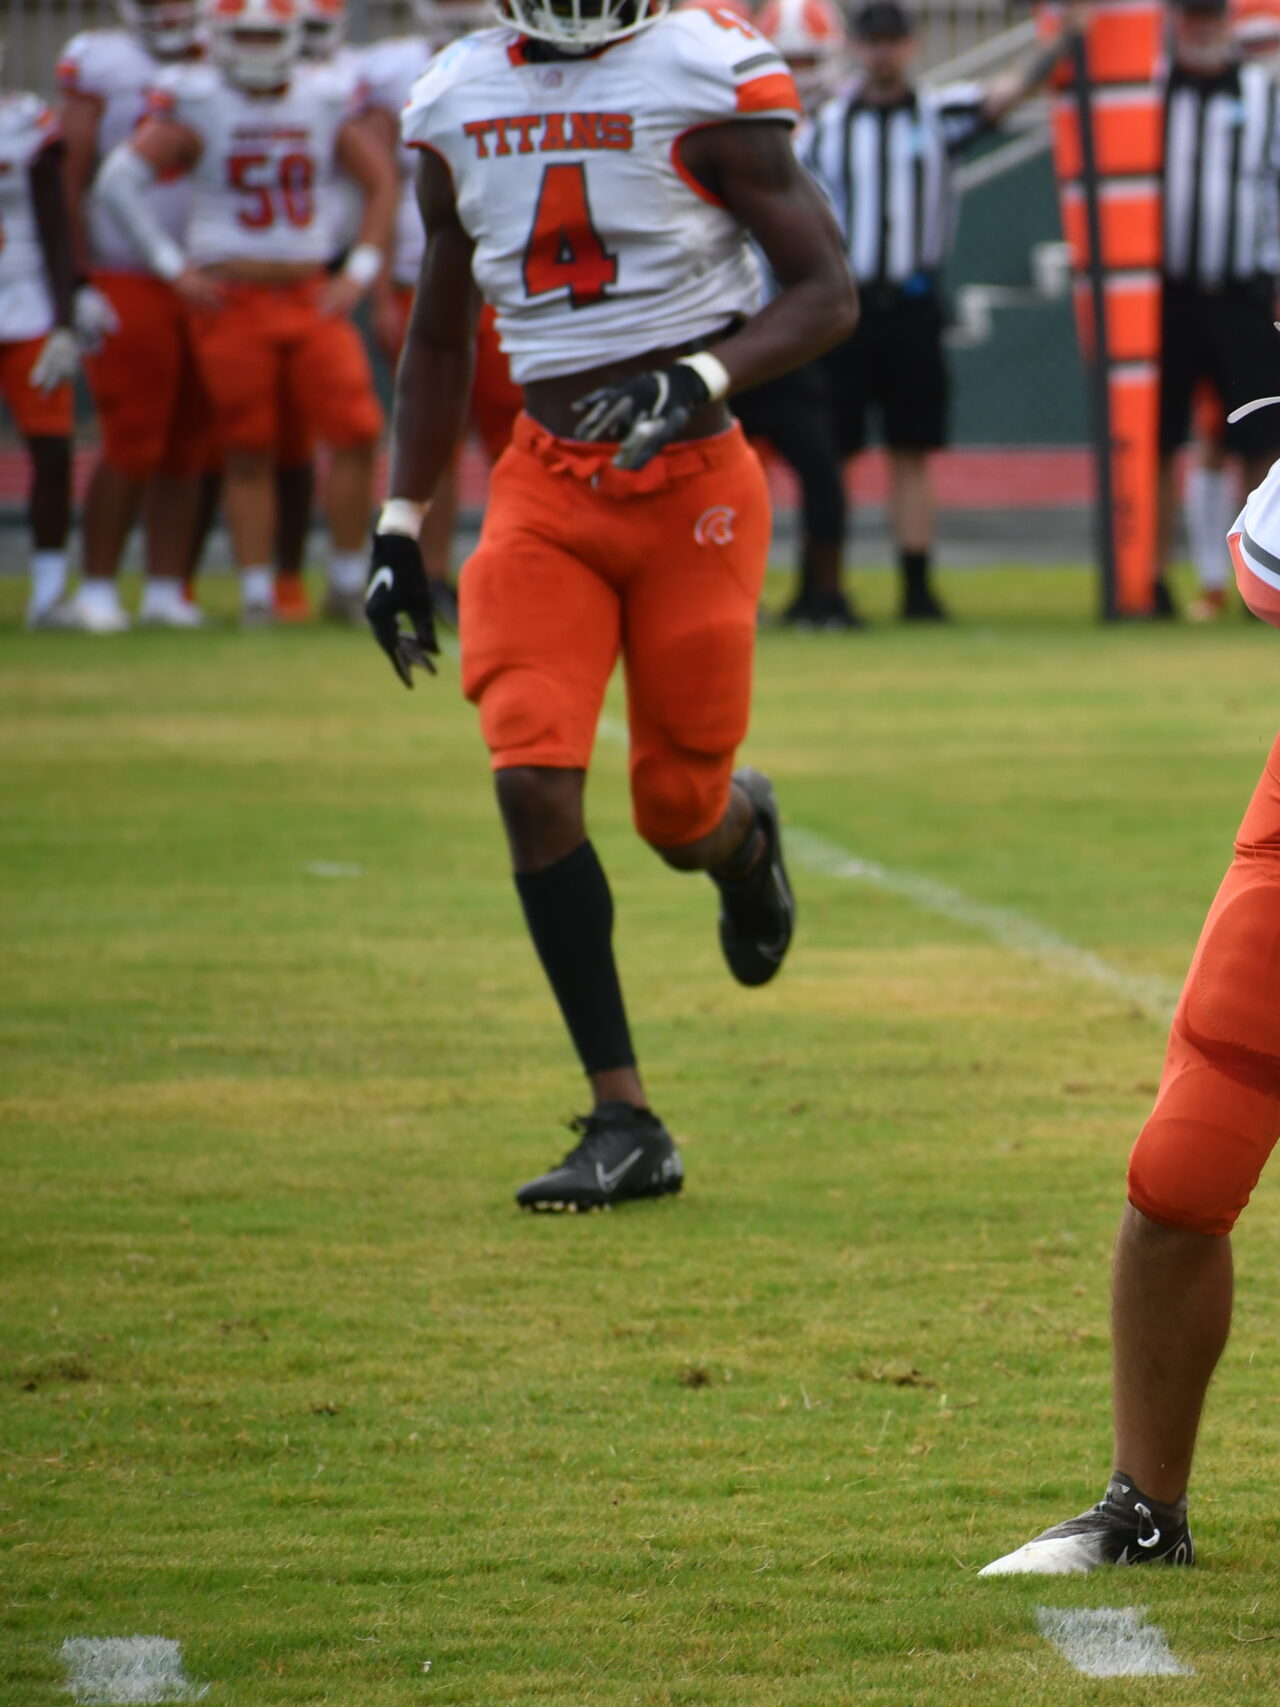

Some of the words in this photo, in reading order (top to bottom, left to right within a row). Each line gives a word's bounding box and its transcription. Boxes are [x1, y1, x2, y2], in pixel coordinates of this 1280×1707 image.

[463, 112, 634, 159] TITANS
[226, 154, 315, 230] 50
[521, 161, 619, 311] 4
